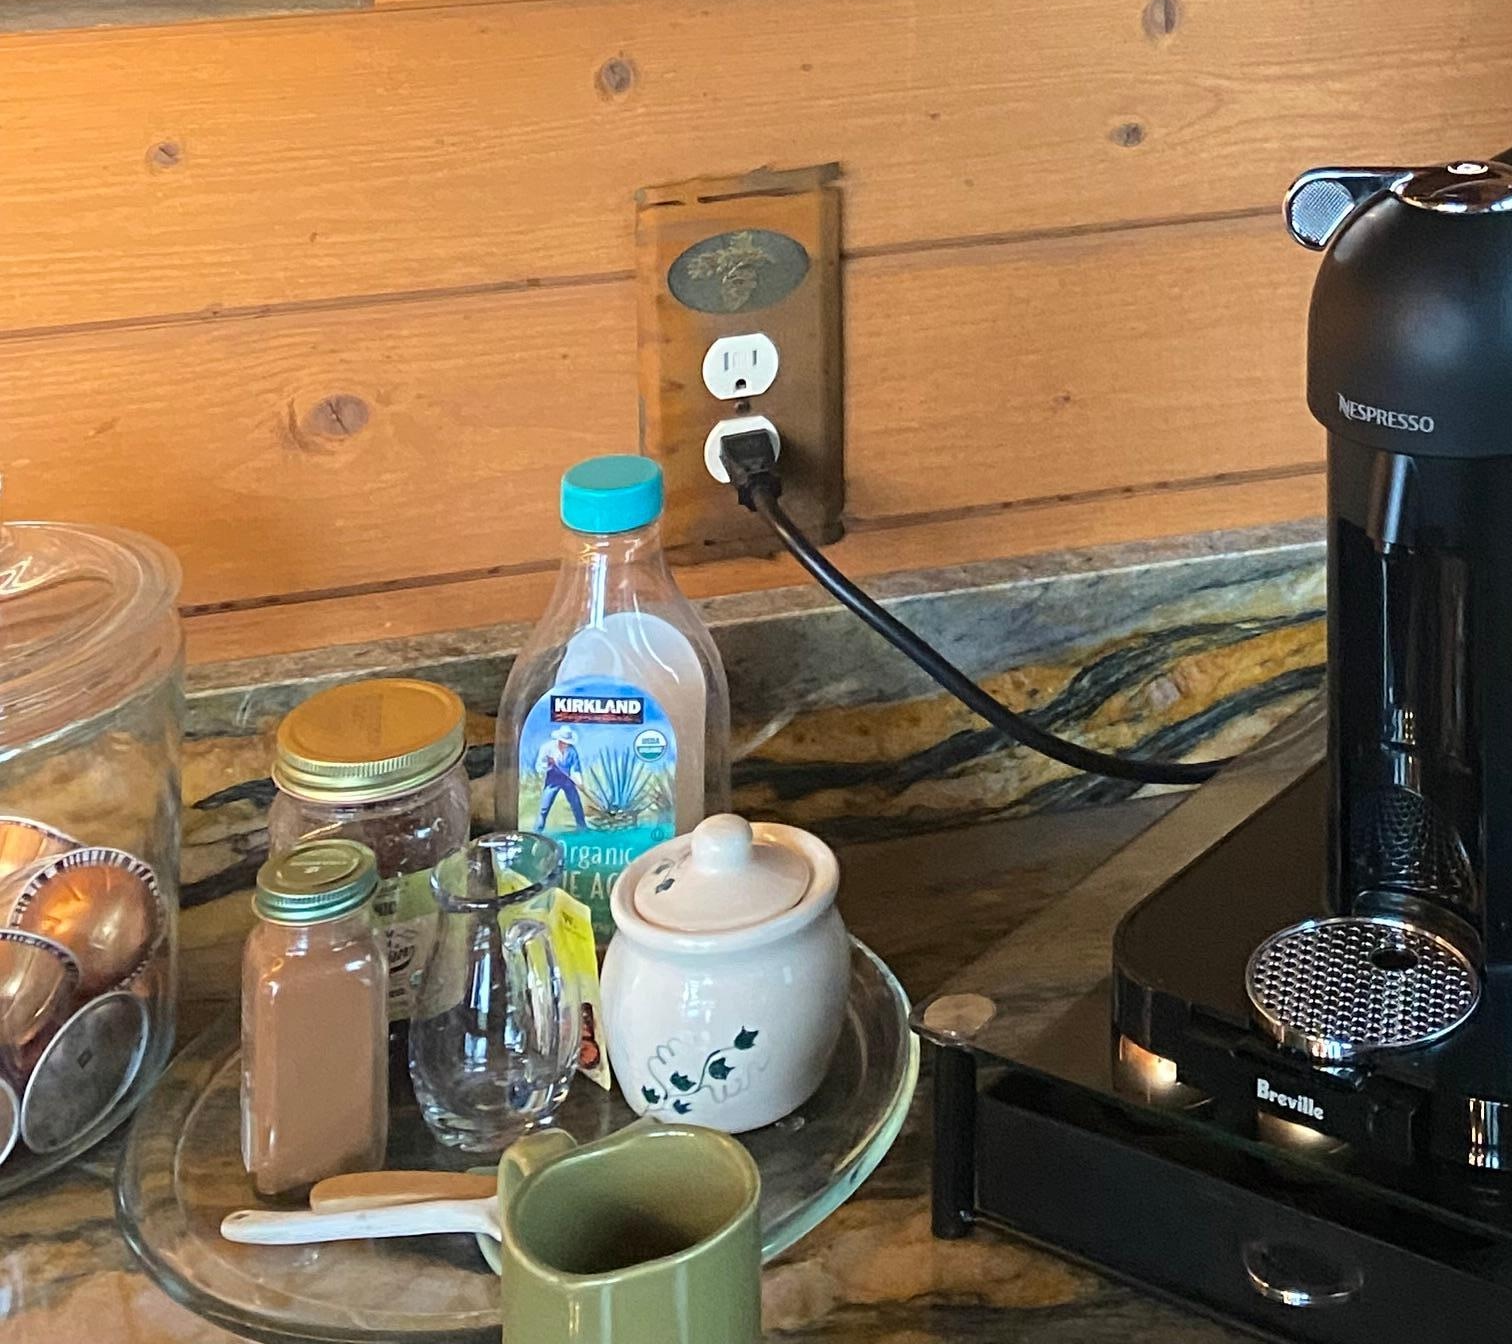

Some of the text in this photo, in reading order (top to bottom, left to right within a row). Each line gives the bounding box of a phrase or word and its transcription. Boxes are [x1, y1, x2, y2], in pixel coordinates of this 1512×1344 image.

[1338, 392, 1435, 434] NESPRESSO
[554, 698, 642, 715] KIRKLAND
[1257, 1078, 1324, 1121] Breville
